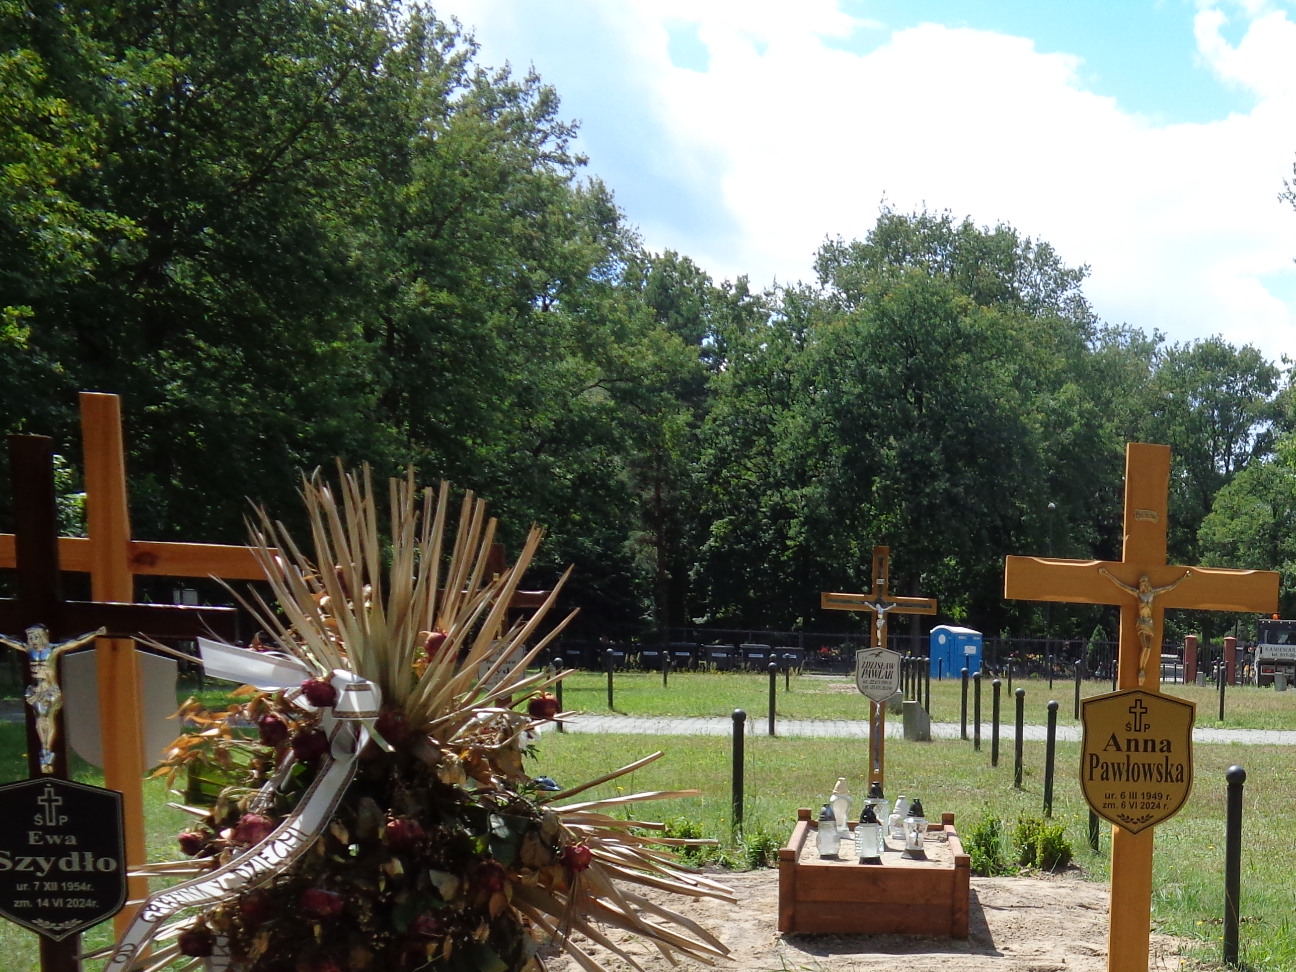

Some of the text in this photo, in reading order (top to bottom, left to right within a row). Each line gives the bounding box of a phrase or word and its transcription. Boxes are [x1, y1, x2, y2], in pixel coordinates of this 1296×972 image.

[861, 668, 893, 679] PAWLAK
[1102, 732, 1172, 753] Anna
[1088, 753, 1184, 784] Pawłowska
[1104, 791, 1172, 801] ur. 6 III 1949 r.
[1102, 801, 1169, 810] zm. 6 VI 2024 r.
[27, 830, 78, 845] Ewa
[0, 850, 117, 877] Szydło
[16, 881, 94, 892] ur. 7 XII 1954r.
[13, 898, 100, 908] zm. 14 VI 2024r.
[112, 942, 138, 964] OD
